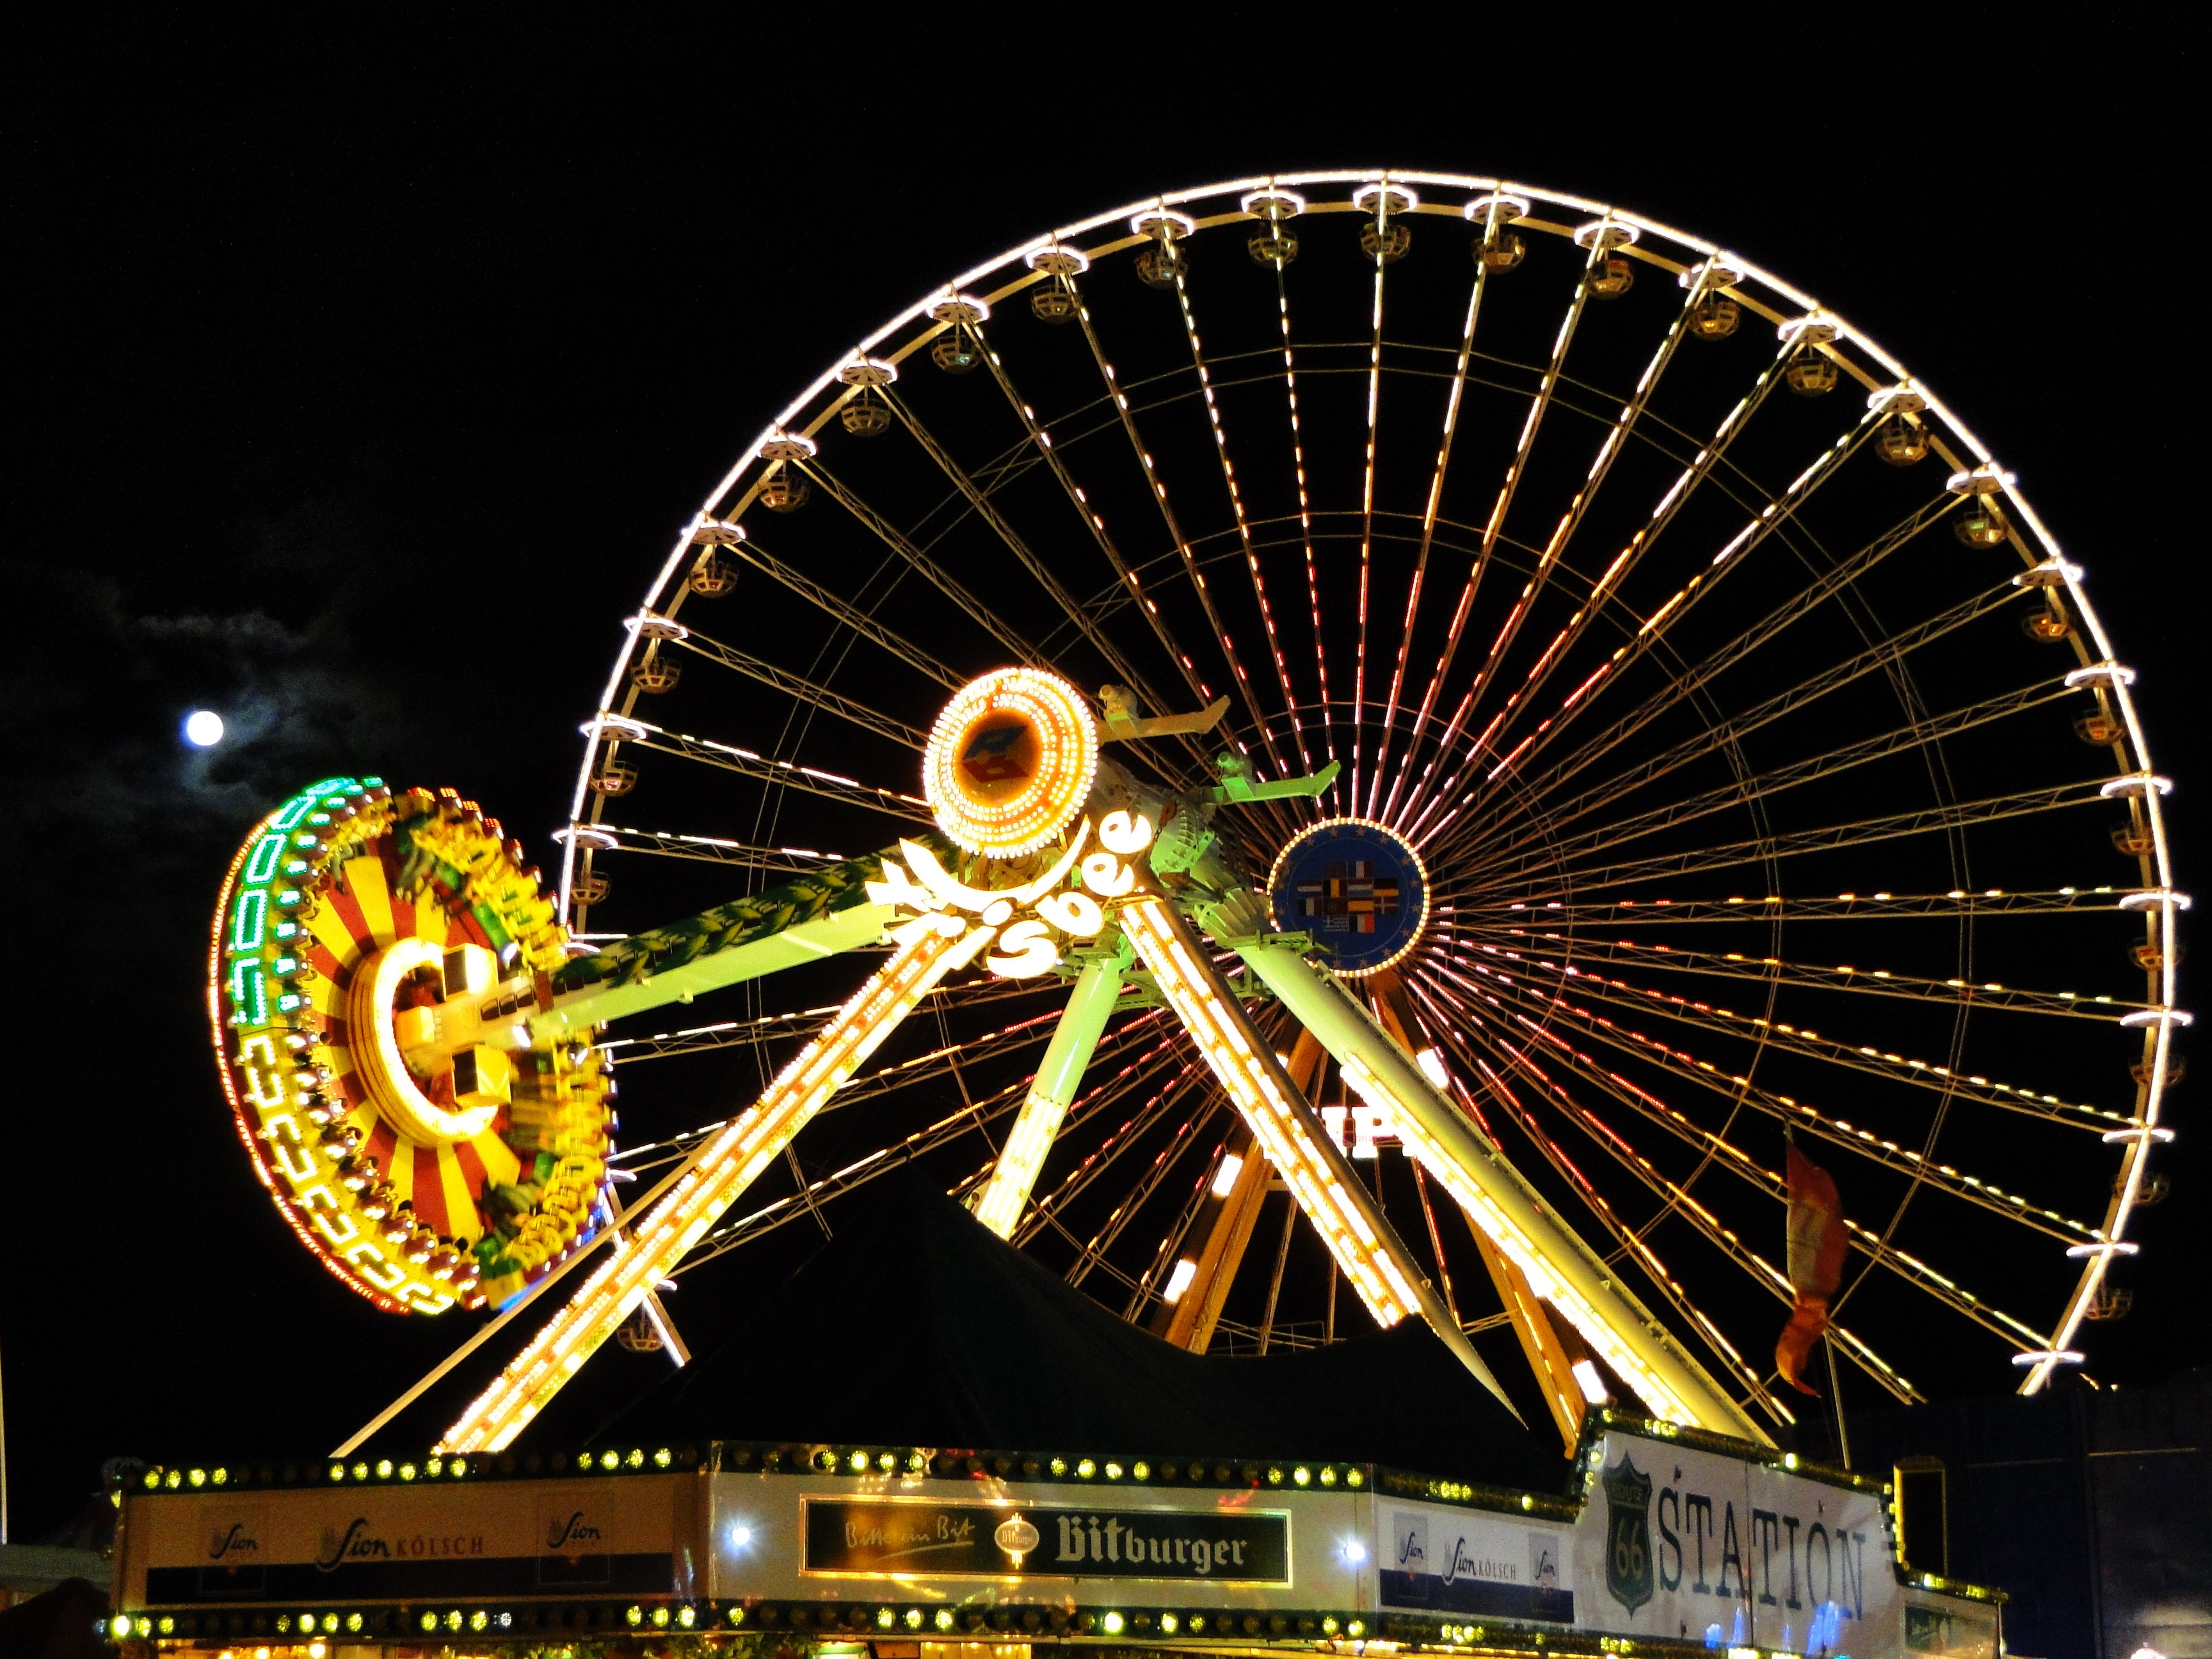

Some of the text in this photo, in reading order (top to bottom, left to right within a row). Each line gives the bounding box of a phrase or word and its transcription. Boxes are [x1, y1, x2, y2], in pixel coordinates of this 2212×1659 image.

[316, 1517, 484, 1569] Sion KÖLSCH
[547, 1511, 601, 1549] Sion
[937, 1514, 976, 1541] Bit
[1055, 1515, 1247, 1575] Bitburger
[1399, 1531, 1424, 1564] Sion
[1616, 1517, 1644, 1580] 66
[1441, 1536, 1516, 1583] Sion KÖLSCH
[1658, 1486, 1866, 1621] STATION
